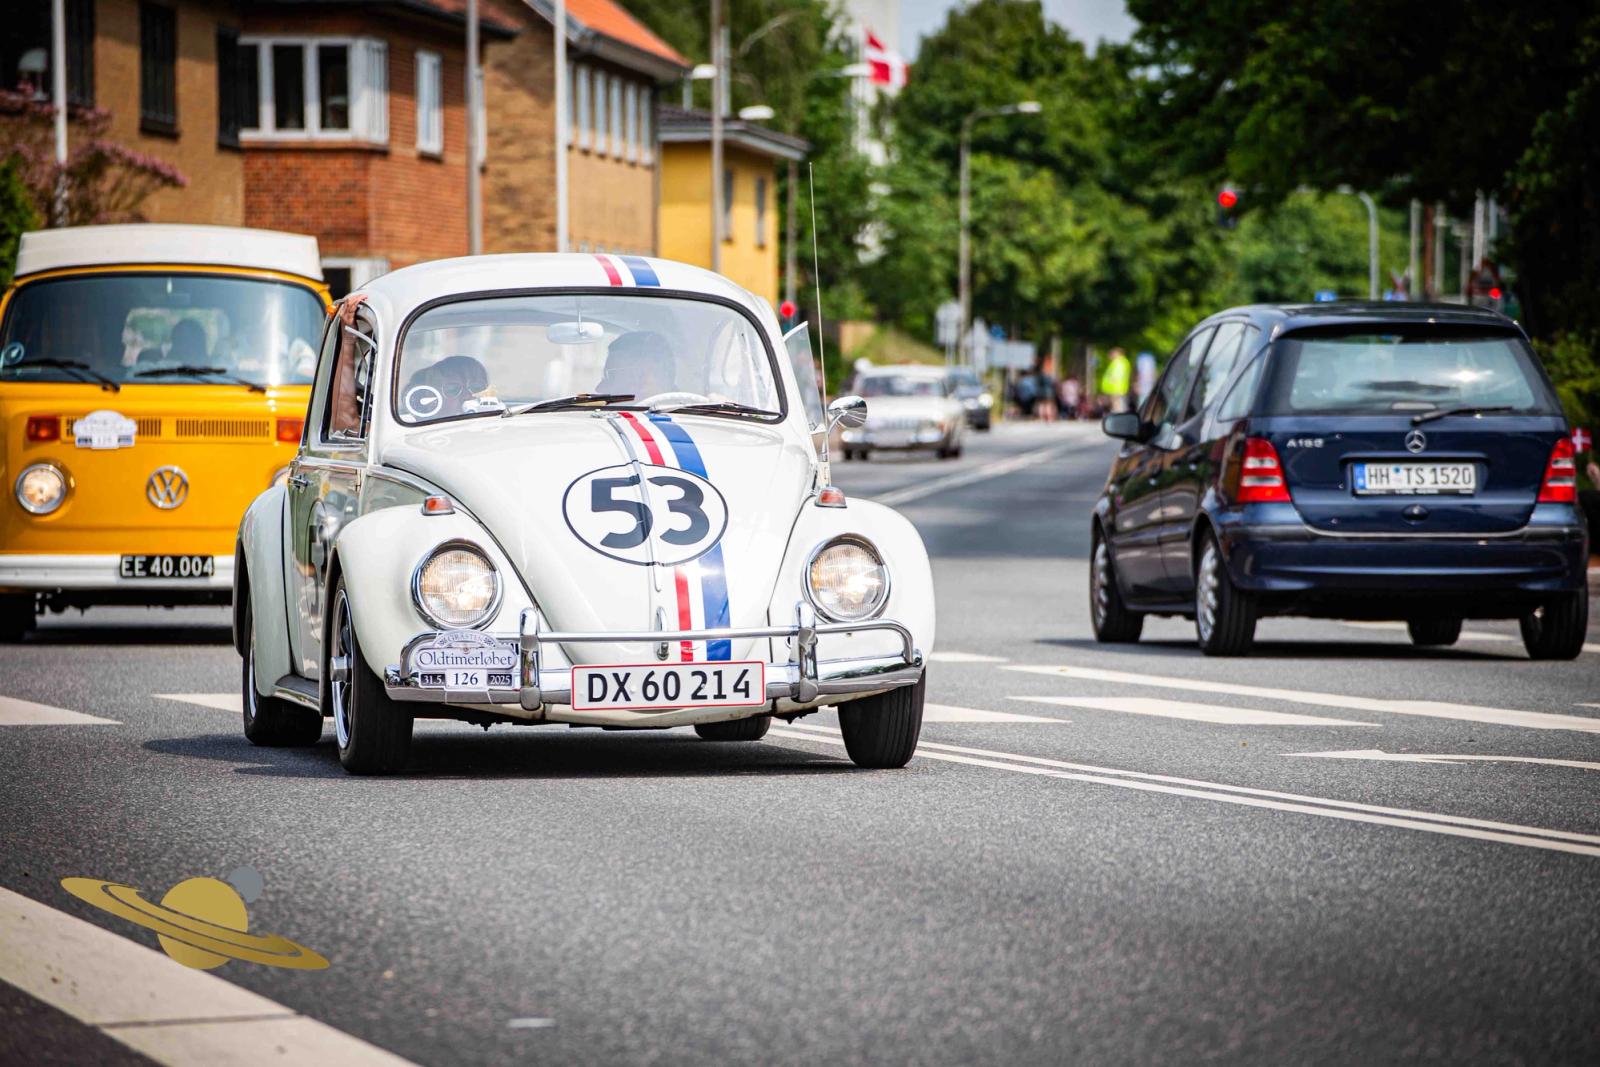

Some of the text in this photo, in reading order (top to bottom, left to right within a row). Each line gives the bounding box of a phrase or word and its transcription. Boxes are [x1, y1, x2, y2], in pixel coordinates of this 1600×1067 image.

[1368, 467, 1472, 485] HH TS 1520
[148, 466, 188, 509] VW
[591, 474, 710, 549] 53
[121, 555, 213, 577] EE 40.004
[419, 651, 512, 666] Oldtimerløbet
[453, 672, 479, 686] 126
[489, 674, 511, 685] 2025
[587, 669, 750, 703] DX 60 214
